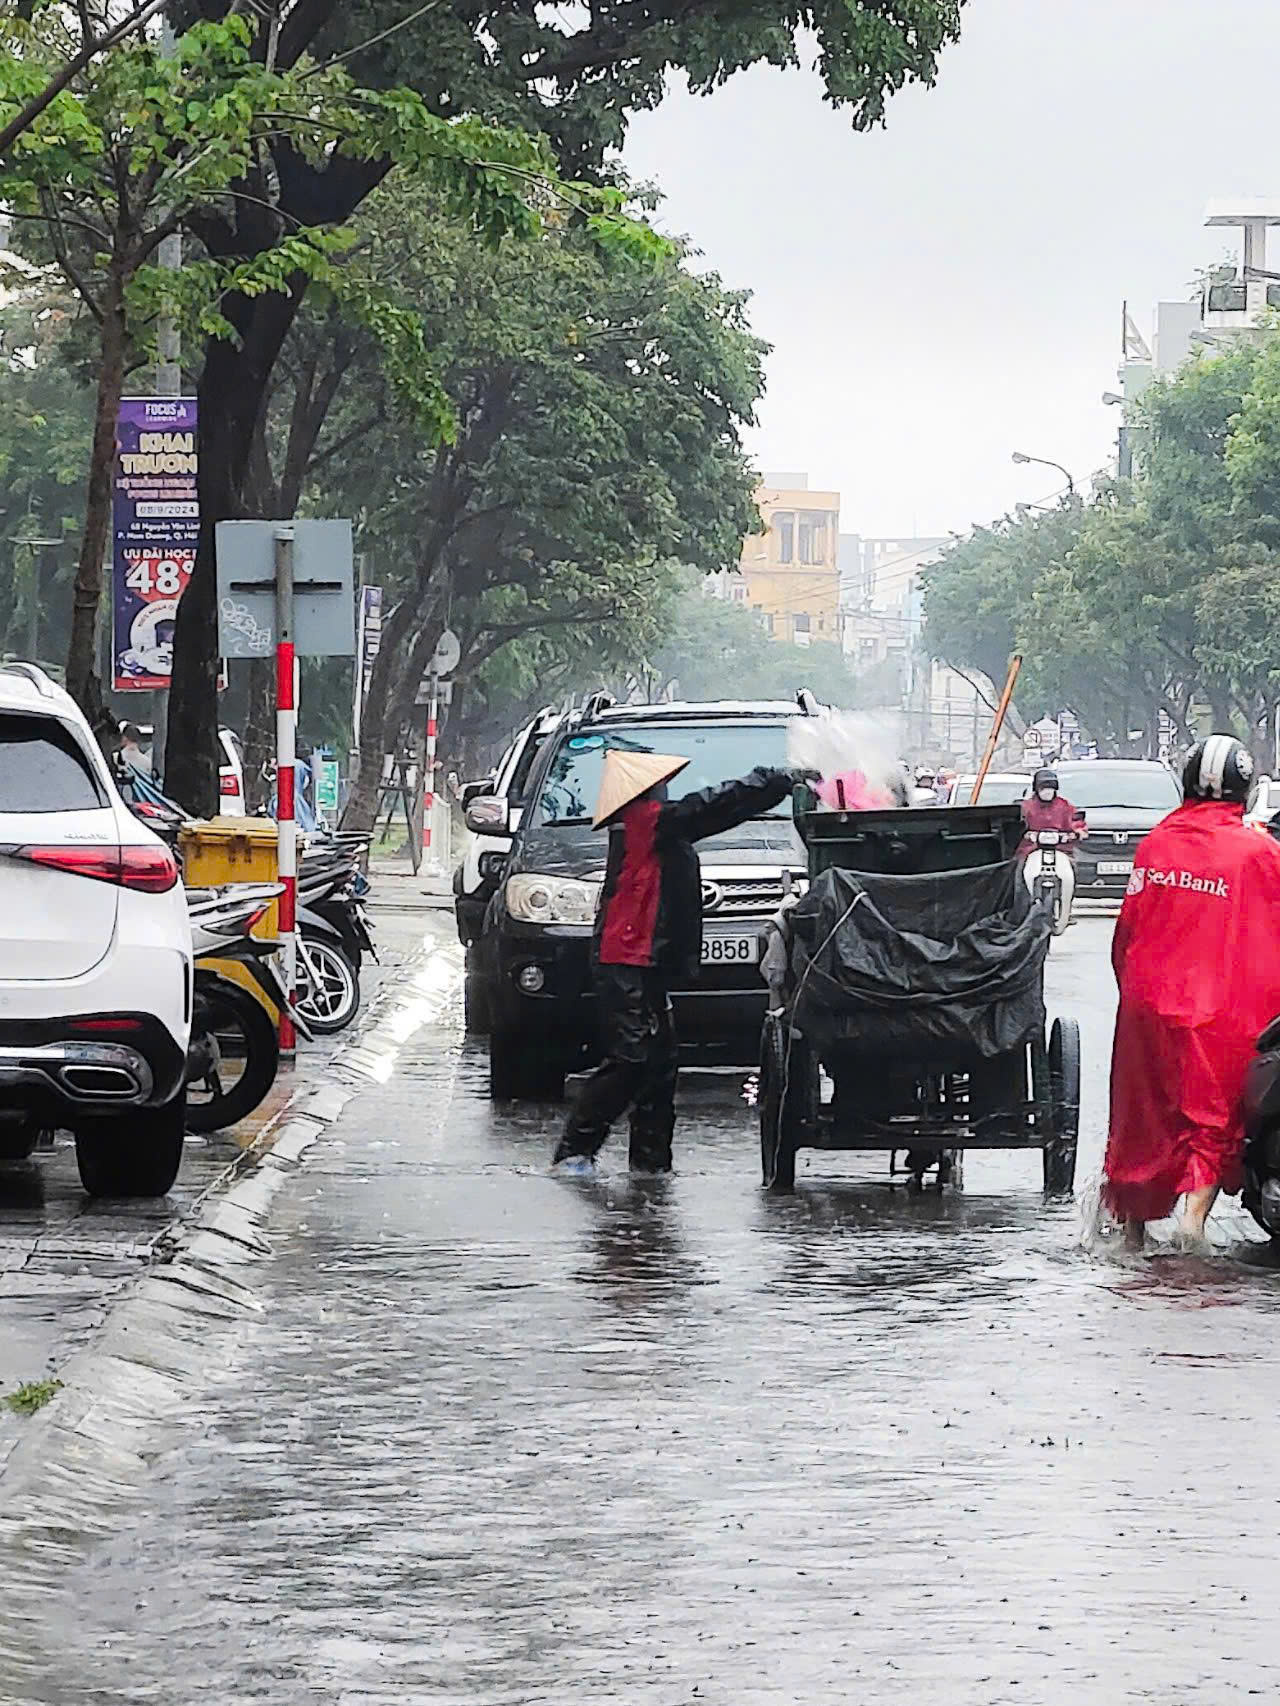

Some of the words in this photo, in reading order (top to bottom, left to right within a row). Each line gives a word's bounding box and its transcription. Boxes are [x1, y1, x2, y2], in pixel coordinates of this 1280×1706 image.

[145, 403, 177, 416] FOCUS
[139, 432, 194, 453] KHAI
[1147, 868, 1229, 897] SeABank
